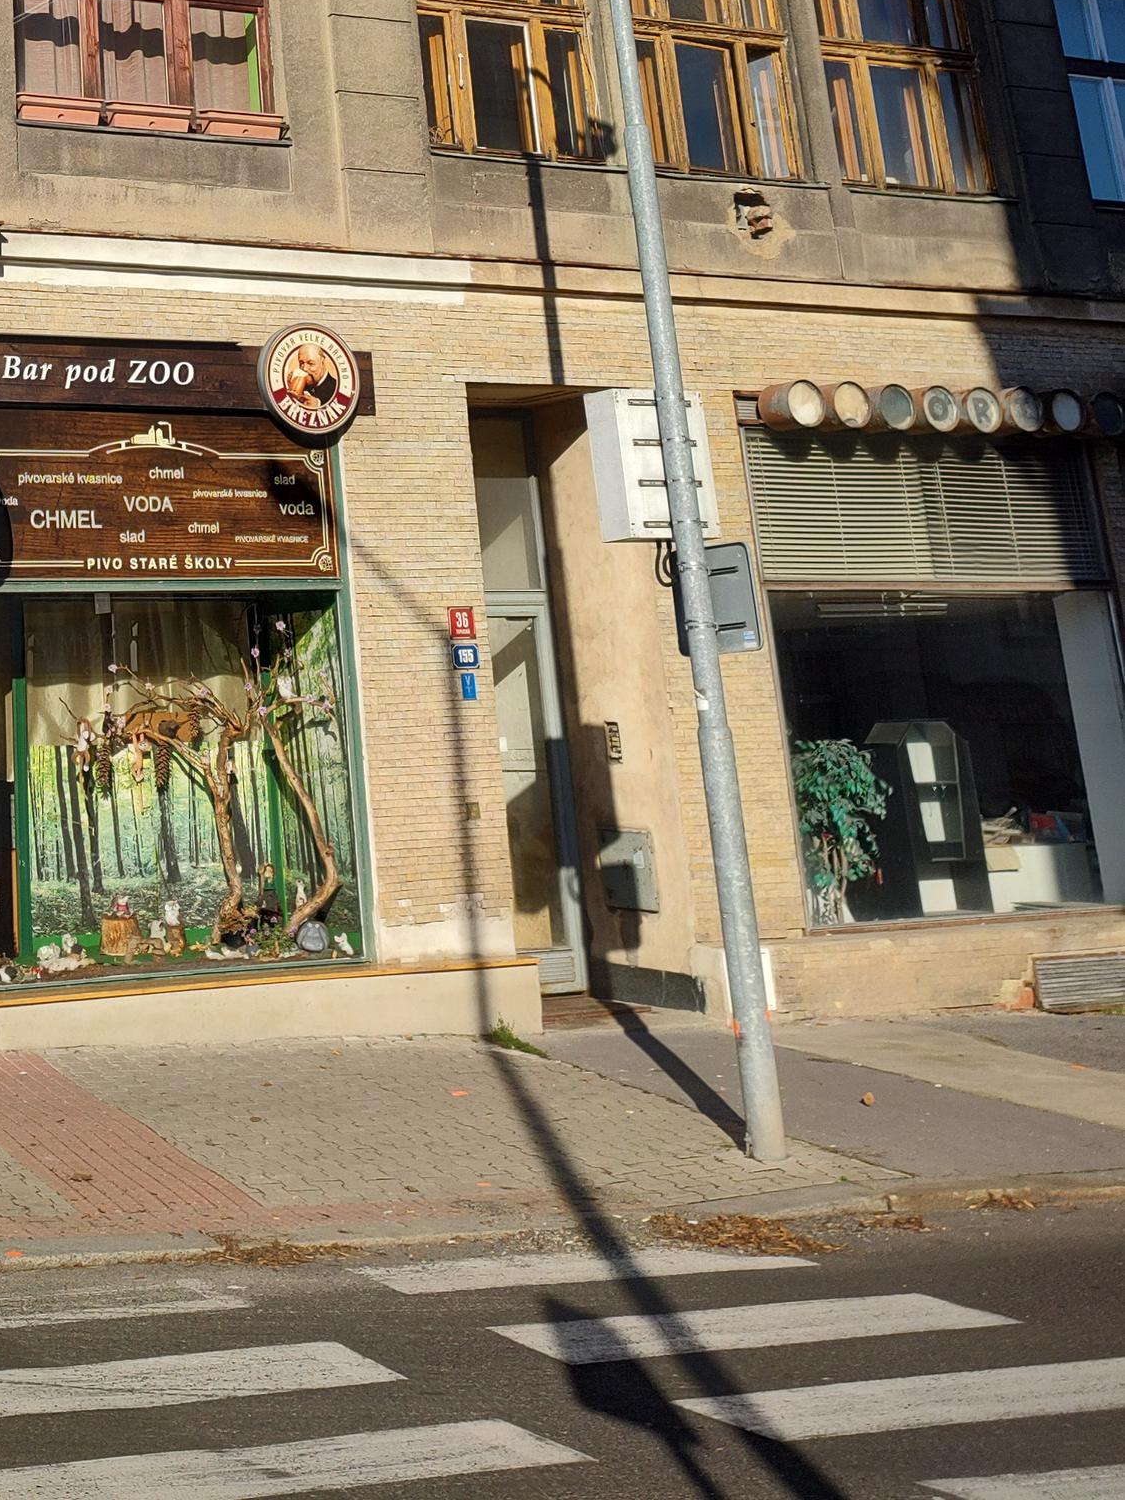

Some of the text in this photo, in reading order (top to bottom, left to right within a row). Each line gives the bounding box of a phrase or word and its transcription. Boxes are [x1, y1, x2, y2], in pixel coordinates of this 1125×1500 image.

[272, 337, 296, 374] PIVOVAR
[2, 355, 194, 389] Bar pod ZOO
[18, 472, 123, 486] pivovarské kvasnice
[149, 466, 184, 480] chmel
[274, 474, 296, 485] slad
[123, 495, 173, 513] VODA
[279, 500, 315, 516] voda
[30, 509, 103, 529] CHMEL
[187, 521, 220, 534] chmel
[119, 529, 146, 544] slad
[87, 554, 233, 570] PIVO STARÉ ŠKOLY
[455, 611, 469, 628] 36
[458, 648, 474, 663] 155
